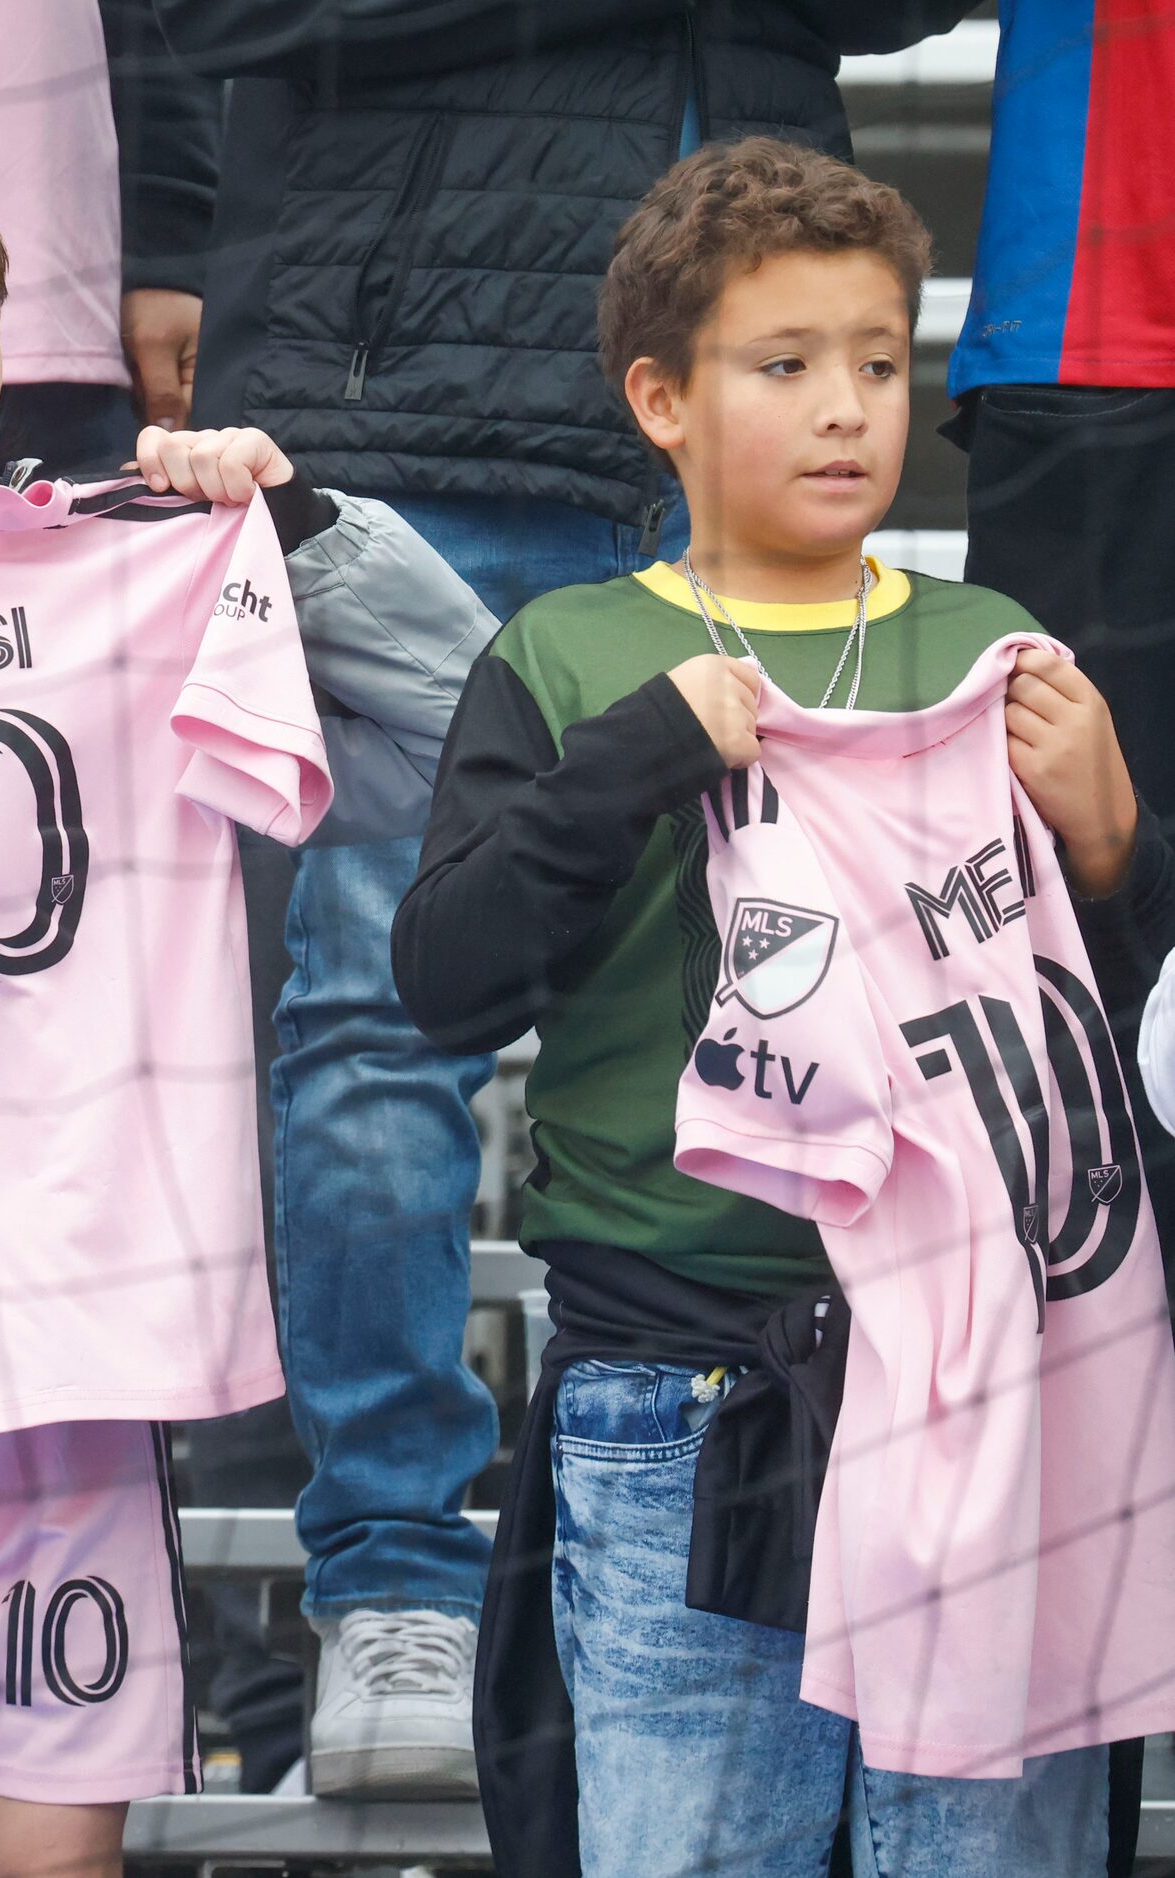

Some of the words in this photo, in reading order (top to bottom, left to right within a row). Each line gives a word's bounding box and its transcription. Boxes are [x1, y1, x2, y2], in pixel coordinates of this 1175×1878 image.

[213, 604, 246, 620] OUP
[223, 579, 272, 622] cht
[741, 911, 793, 938] MLS
[750, 1039, 820, 1105] tv
[1091, 1170, 1109, 1180] MLS
[1, 1575, 129, 1707] 10
